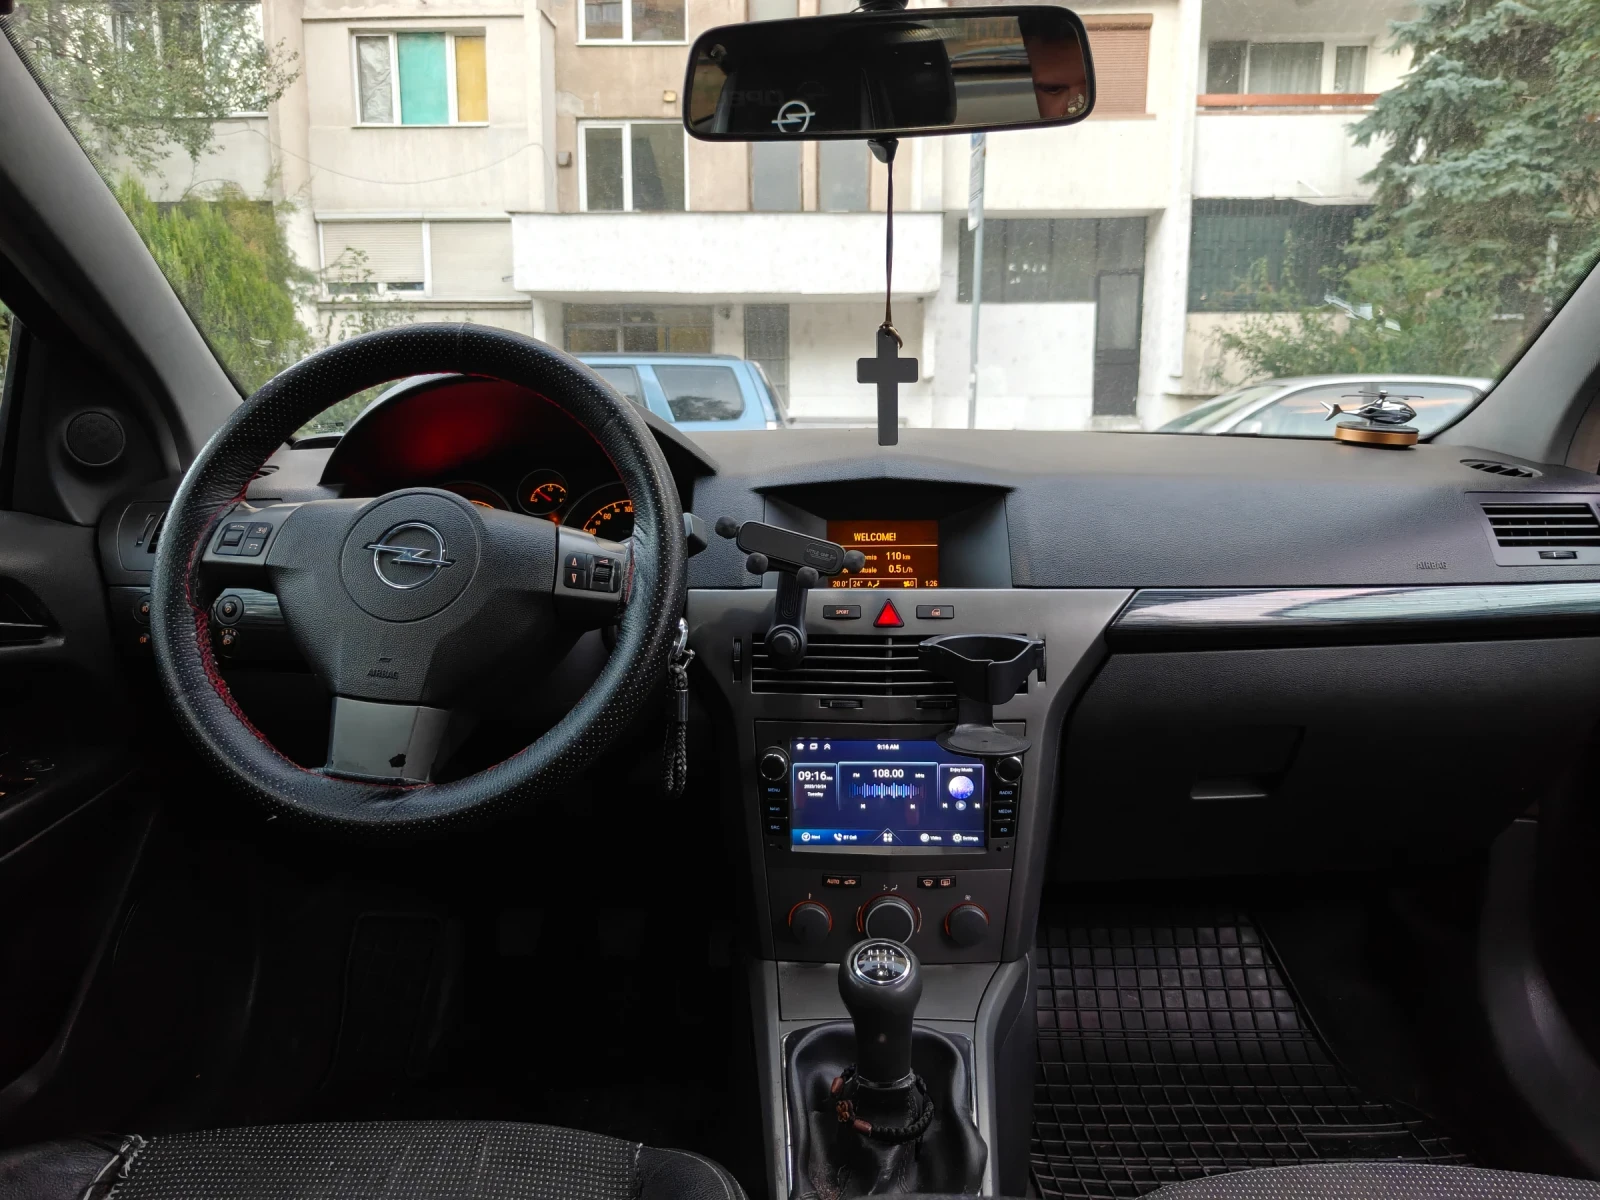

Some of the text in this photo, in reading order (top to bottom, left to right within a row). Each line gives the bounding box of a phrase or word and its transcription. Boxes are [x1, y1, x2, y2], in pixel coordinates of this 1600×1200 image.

[854, 532, 897, 541] WELCOME!
[886, 551, 902, 560] 110
[888, 564, 902, 573] 0.5
[1416, 561, 1449, 570] AIRBAG
[366, 668, 399, 680] AIRBAG
[797, 771, 826, 780] 09:16
[872, 768, 904, 778] 108.00
